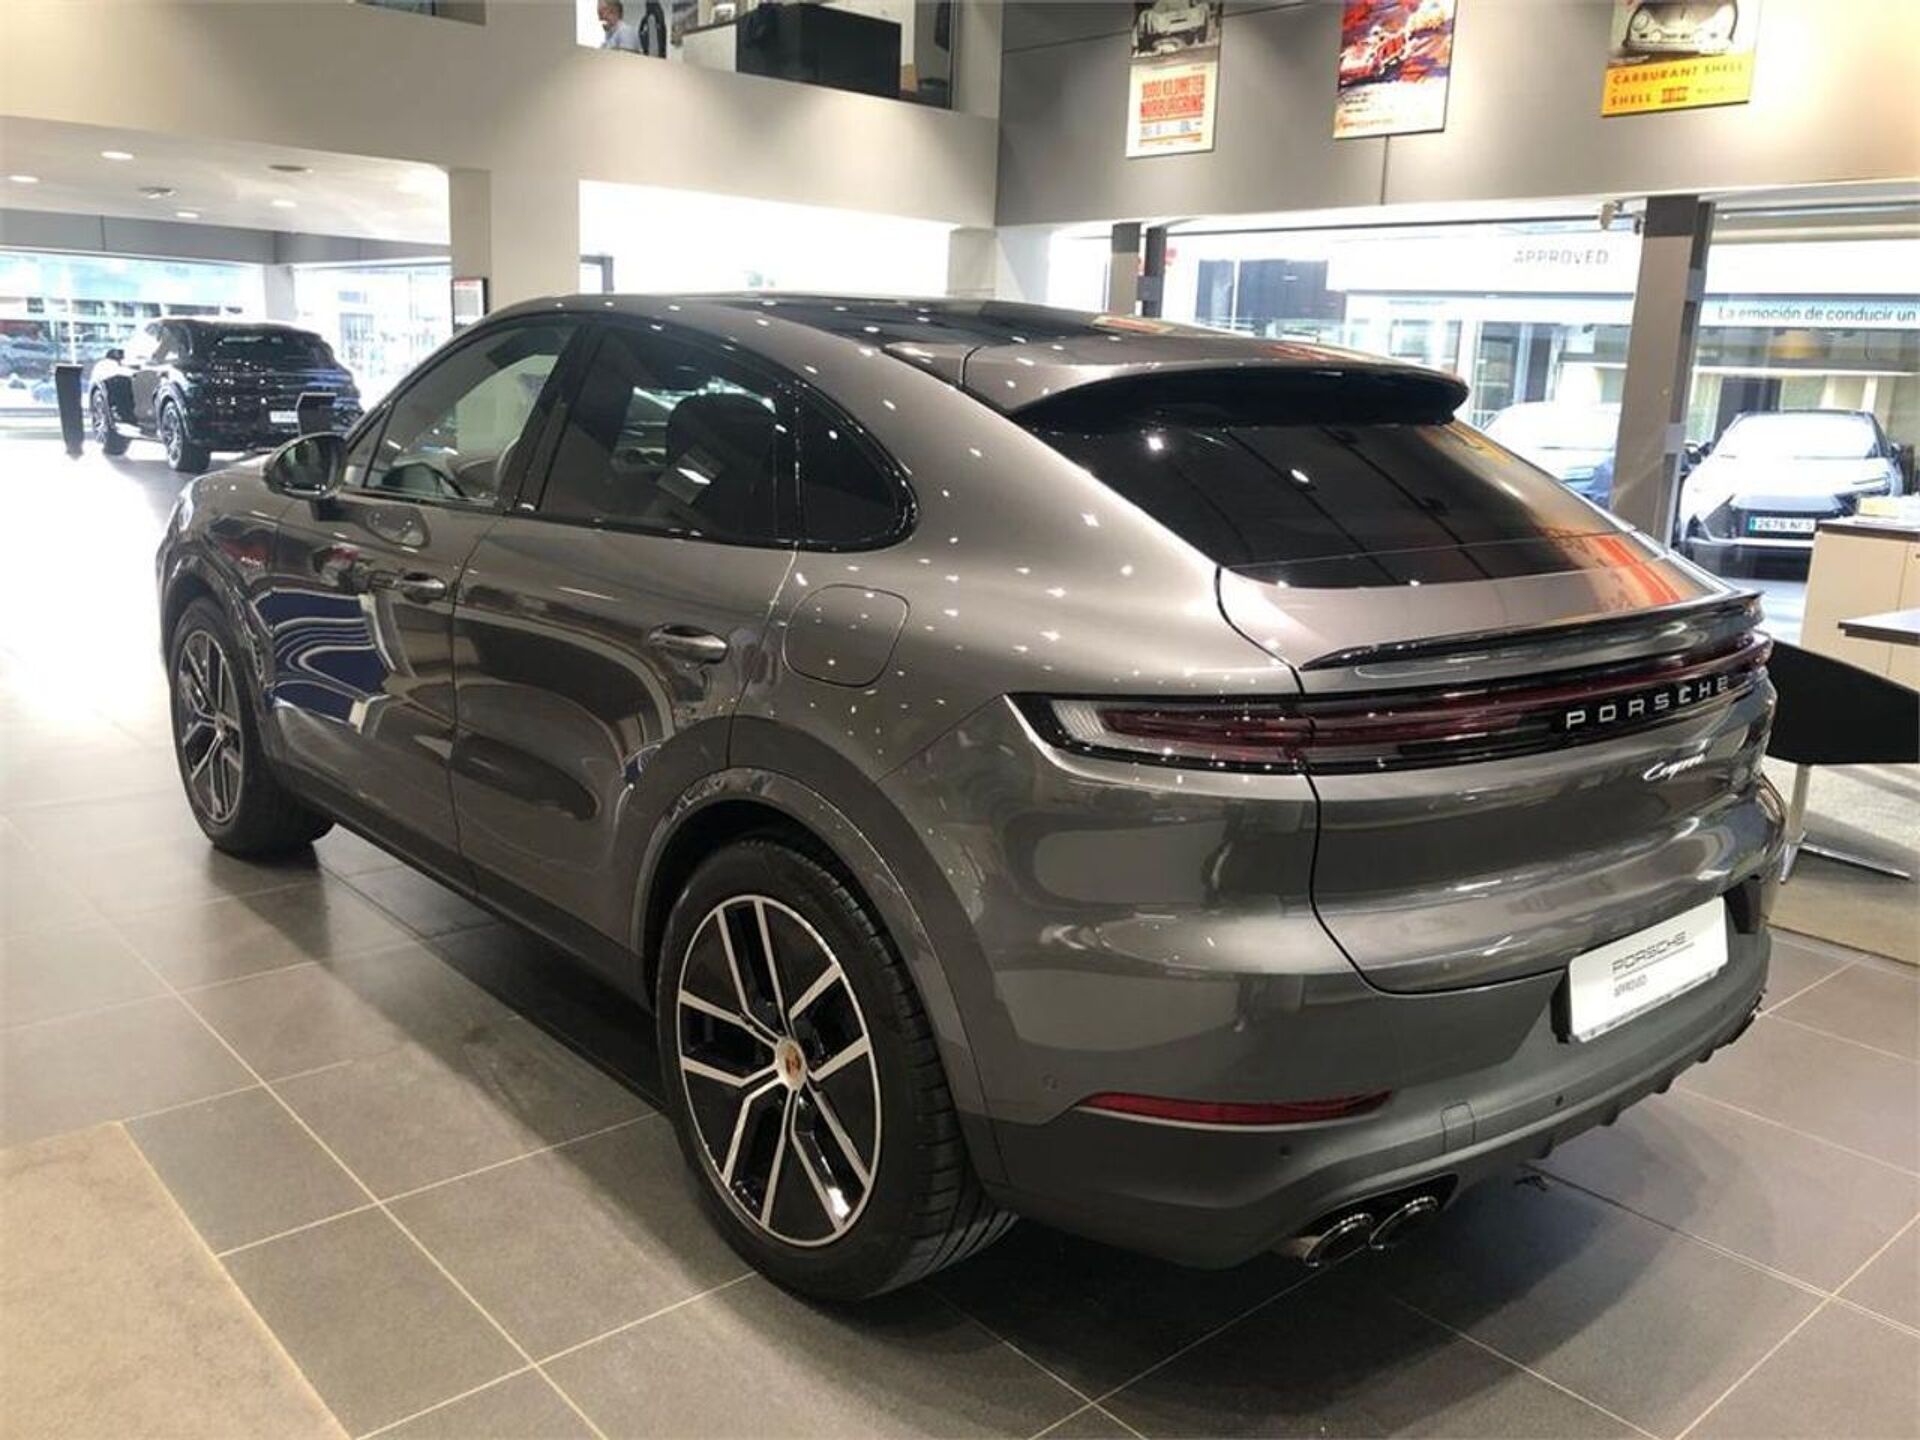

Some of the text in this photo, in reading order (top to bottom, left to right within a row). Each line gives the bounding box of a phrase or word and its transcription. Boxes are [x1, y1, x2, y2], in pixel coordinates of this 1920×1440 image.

[1613, 66, 1698, 84] CARBURANT
[1610, 94, 1651, 106] SHELL
[1513, 248, 1609, 265] APPROVED
[1717, 306, 1917, 322] La emoción de conducir un
[1565, 674, 1730, 730] PORSCHE
[1611, 930, 1687, 974] PORSCHE
